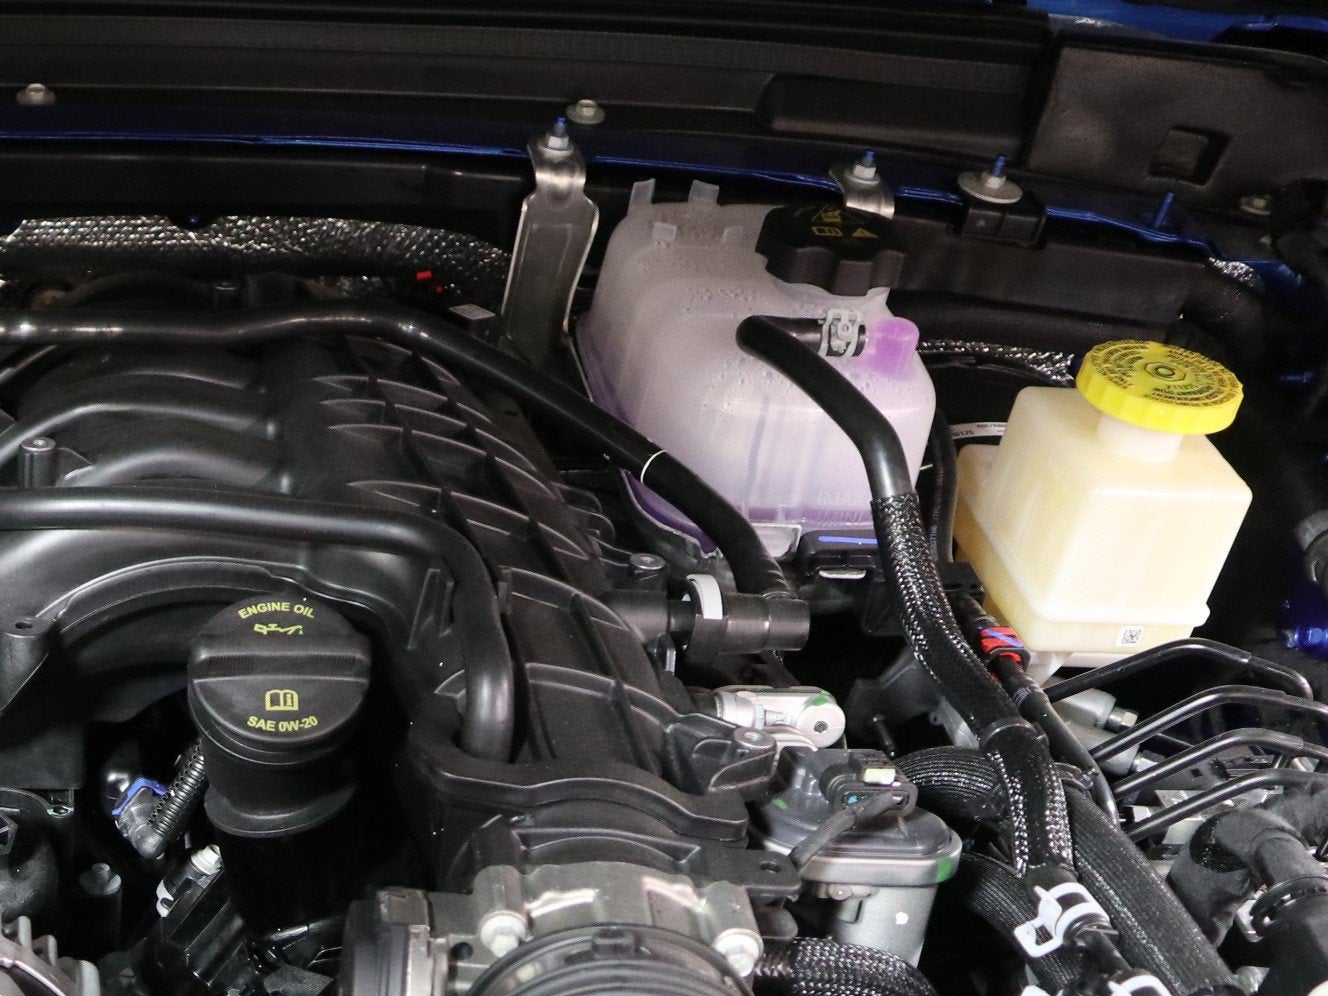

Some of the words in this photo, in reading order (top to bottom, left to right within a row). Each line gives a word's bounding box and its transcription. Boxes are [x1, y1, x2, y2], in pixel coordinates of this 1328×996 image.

[237, 602, 291, 619] ENGINE
[293, 604, 314, 618] OIL
[247, 716, 276, 731] SAE
[278, 716, 319, 731] 0W-20
